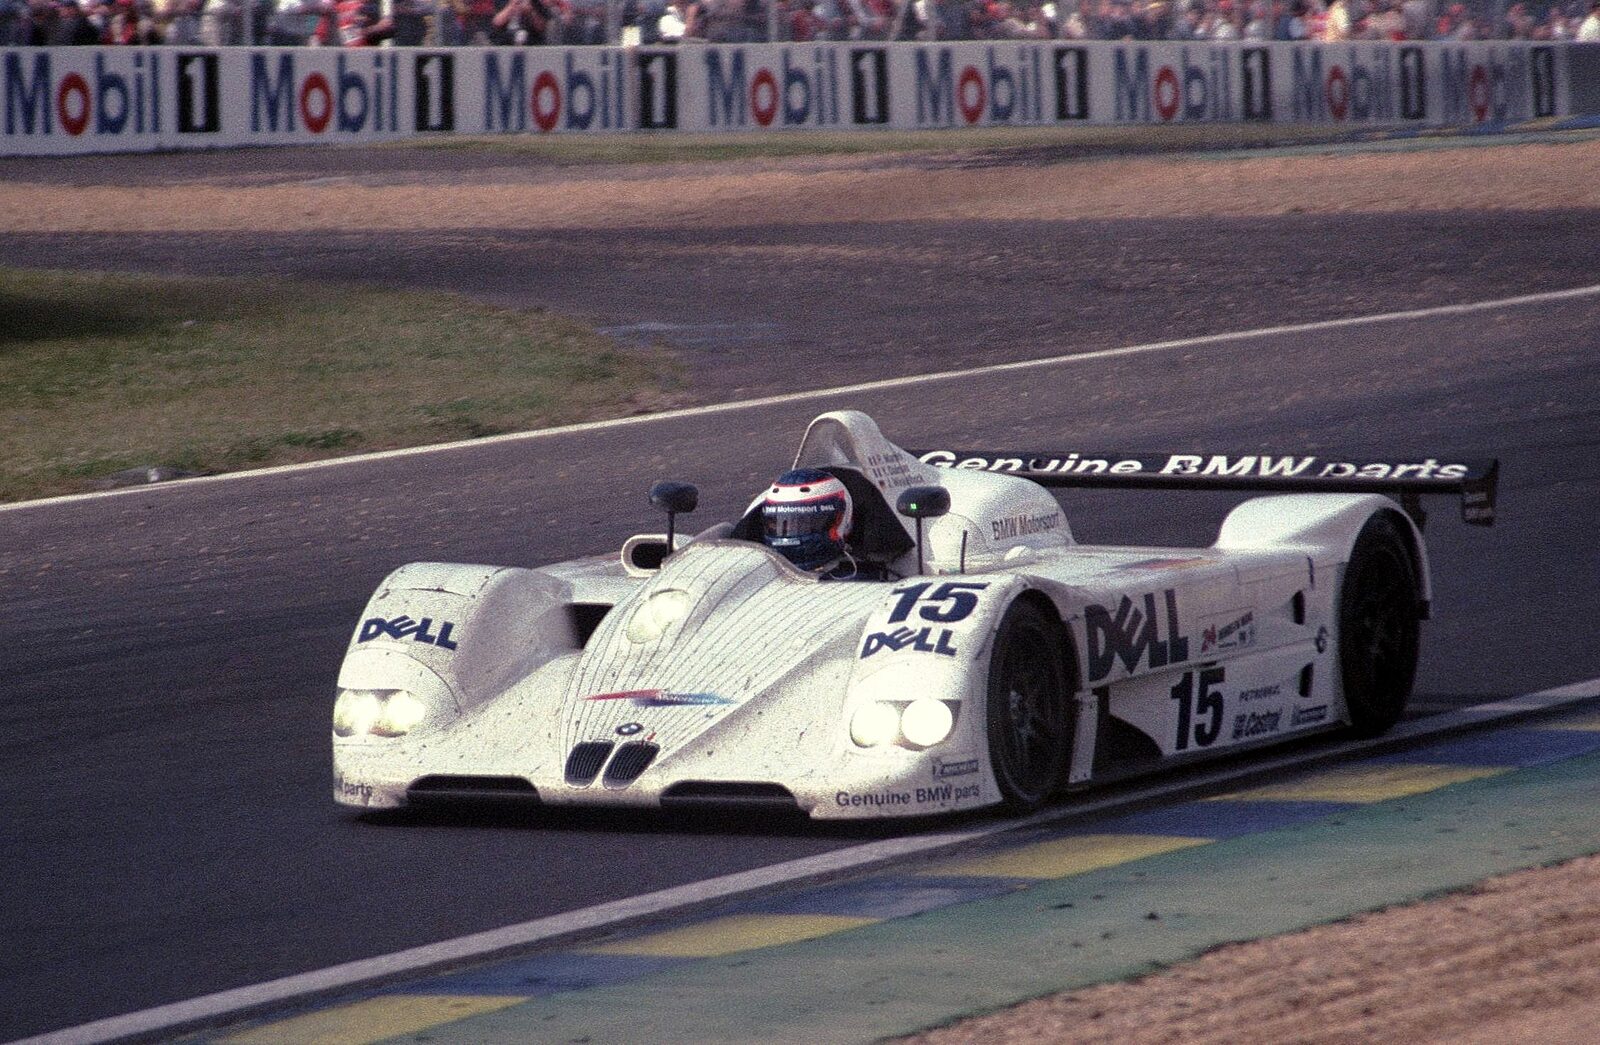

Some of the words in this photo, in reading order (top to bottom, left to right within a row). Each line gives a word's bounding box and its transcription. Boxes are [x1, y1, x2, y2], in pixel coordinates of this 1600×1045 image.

[5, 51, 162, 136] Mobil
[251, 53, 398, 134] Mobil
[484, 51, 625, 132] Mobil
[707, 49, 840, 127] Mobil
[915, 48, 1041, 124] Mobil
[1113, 48, 1231, 121] Mobil
[917, 450, 1142, 475] Genuine
[1159, 454, 1317, 477] BMW
[1318, 458, 1468, 479] parts
[777, 504, 818, 514] Motorsport
[991, 517, 1018, 541] BMW
[1018, 511, 1061, 536] Motorsport
[357, 615, 458, 650] DELL
[887, 581, 991, 624] 15
[1084, 589, 1189, 682] DELL
[860, 626, 958, 659] DELL
[1170, 666, 1225, 750] 15
[835, 790, 912, 807] Genuine
[915, 784, 953, 803] BMW
[954, 784, 980, 803] parts
